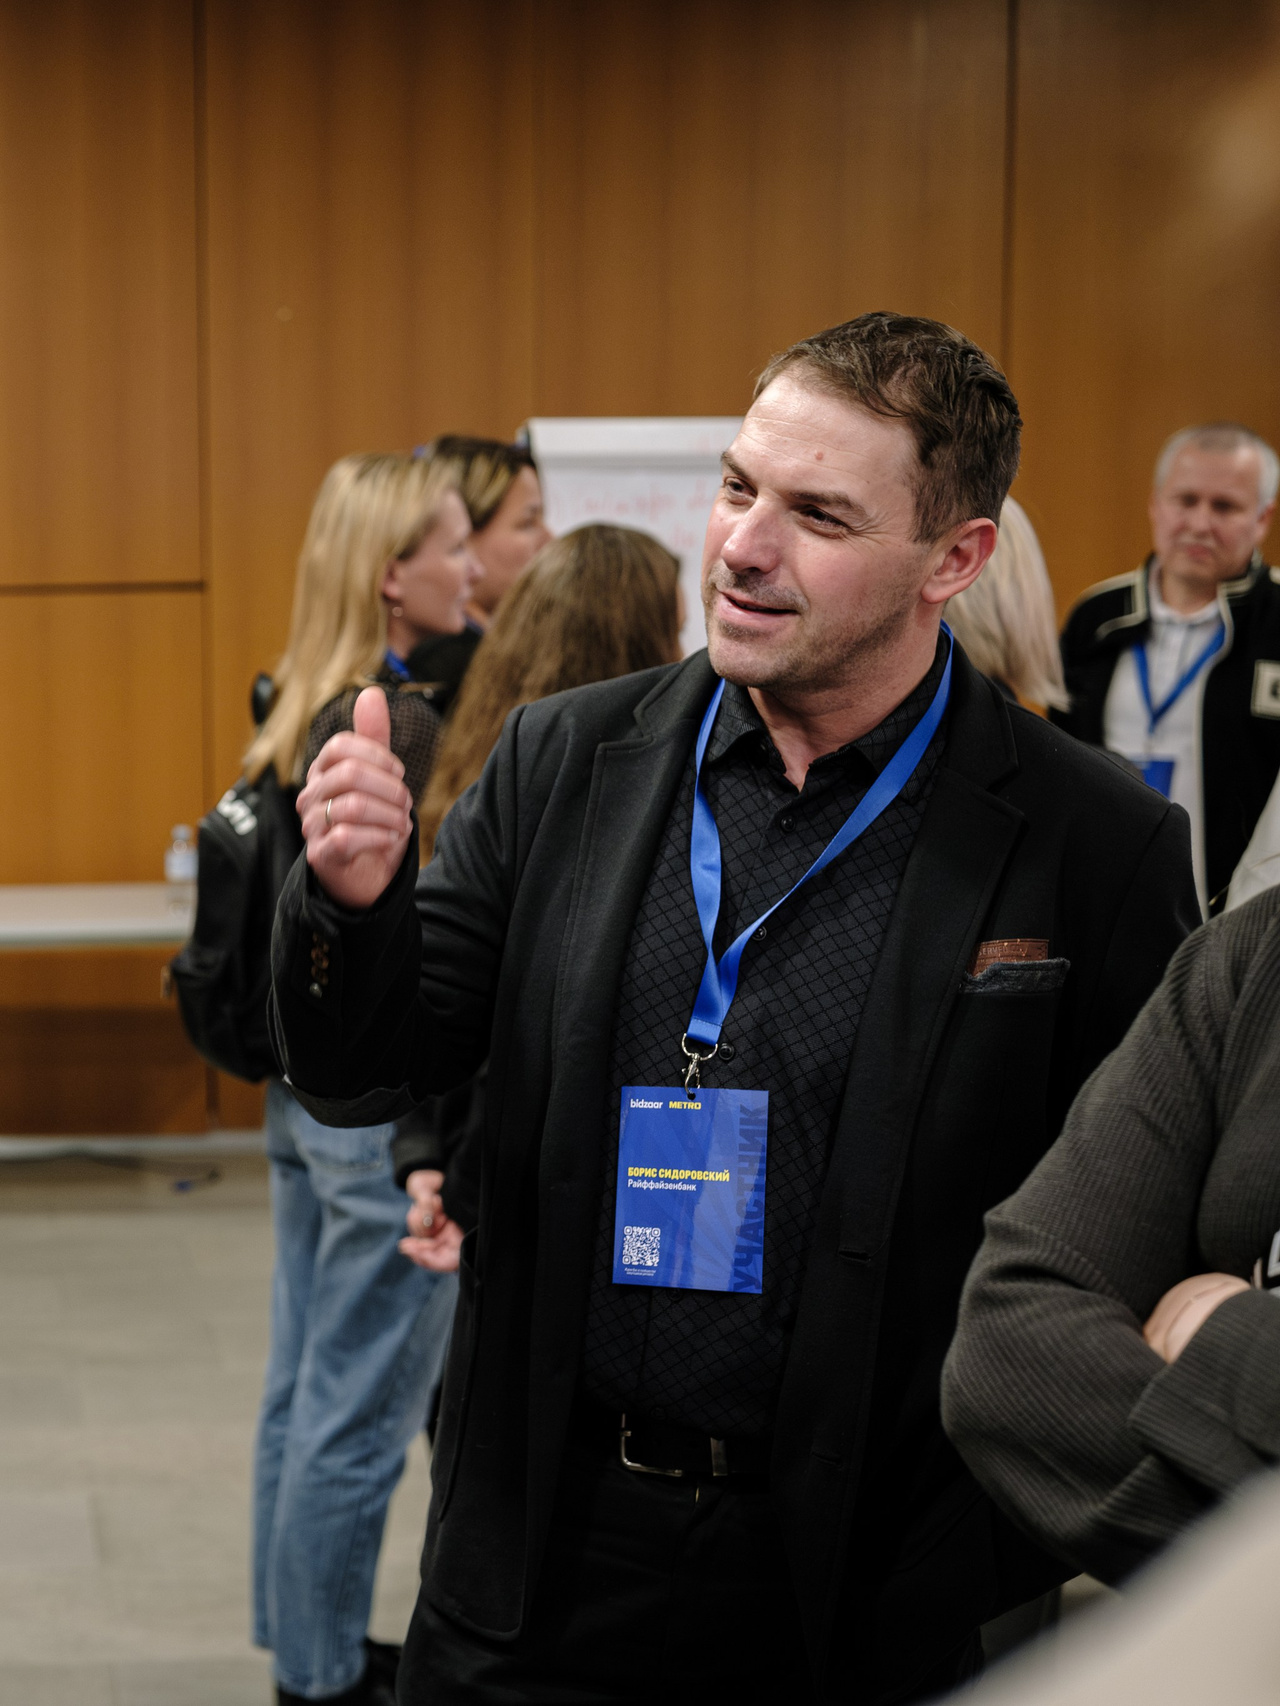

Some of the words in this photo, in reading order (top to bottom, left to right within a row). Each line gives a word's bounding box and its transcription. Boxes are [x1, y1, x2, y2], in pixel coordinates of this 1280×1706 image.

[630, 1098, 663, 1109] bidzaar
[668, 1100, 702, 1110] METRO
[627, 1167, 657, 1178] БОРИС
[658, 1168, 730, 1182] СИДОРОВСКИЙ
[627, 1178, 697, 1191] Райффайзенбанк
[733, 1103, 768, 1291] УЧАСТНИК
